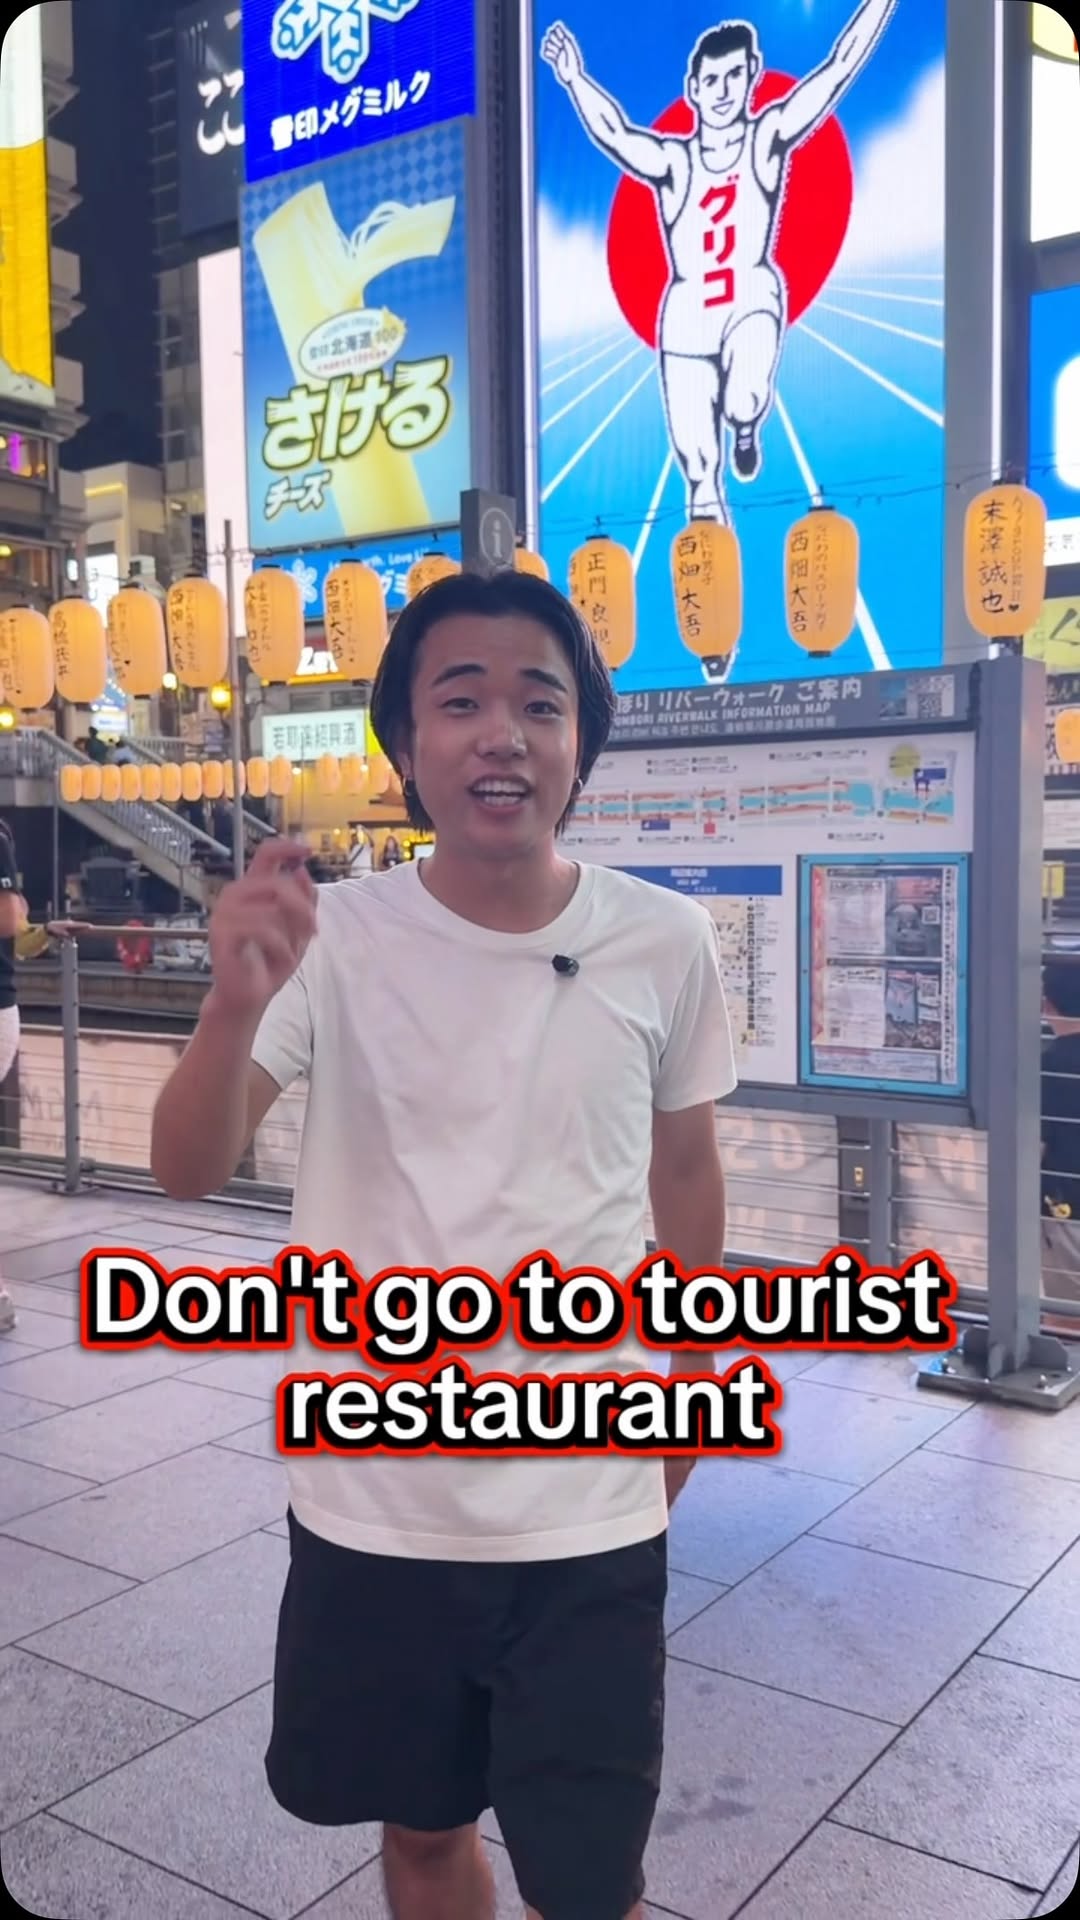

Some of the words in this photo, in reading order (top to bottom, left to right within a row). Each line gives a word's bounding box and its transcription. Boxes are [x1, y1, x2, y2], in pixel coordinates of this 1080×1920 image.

[270, 70, 431, 152] 雪印メグミルク
[699, 173, 740, 309] グリコ
[262, 354, 450, 471] さける
[264, 469, 332, 520] チーズ
[677, 535, 702, 637] 西畑大吾
[790, 529, 809, 633] 西畑大吾
[657, 709, 718, 725] RIVERWALK
[722, 704, 801, 721] INFORMATION
[804, 701, 831, 715] MAP
[659, 684, 784, 711] リバーウォーク
[797, 678, 862, 701] ご案内
